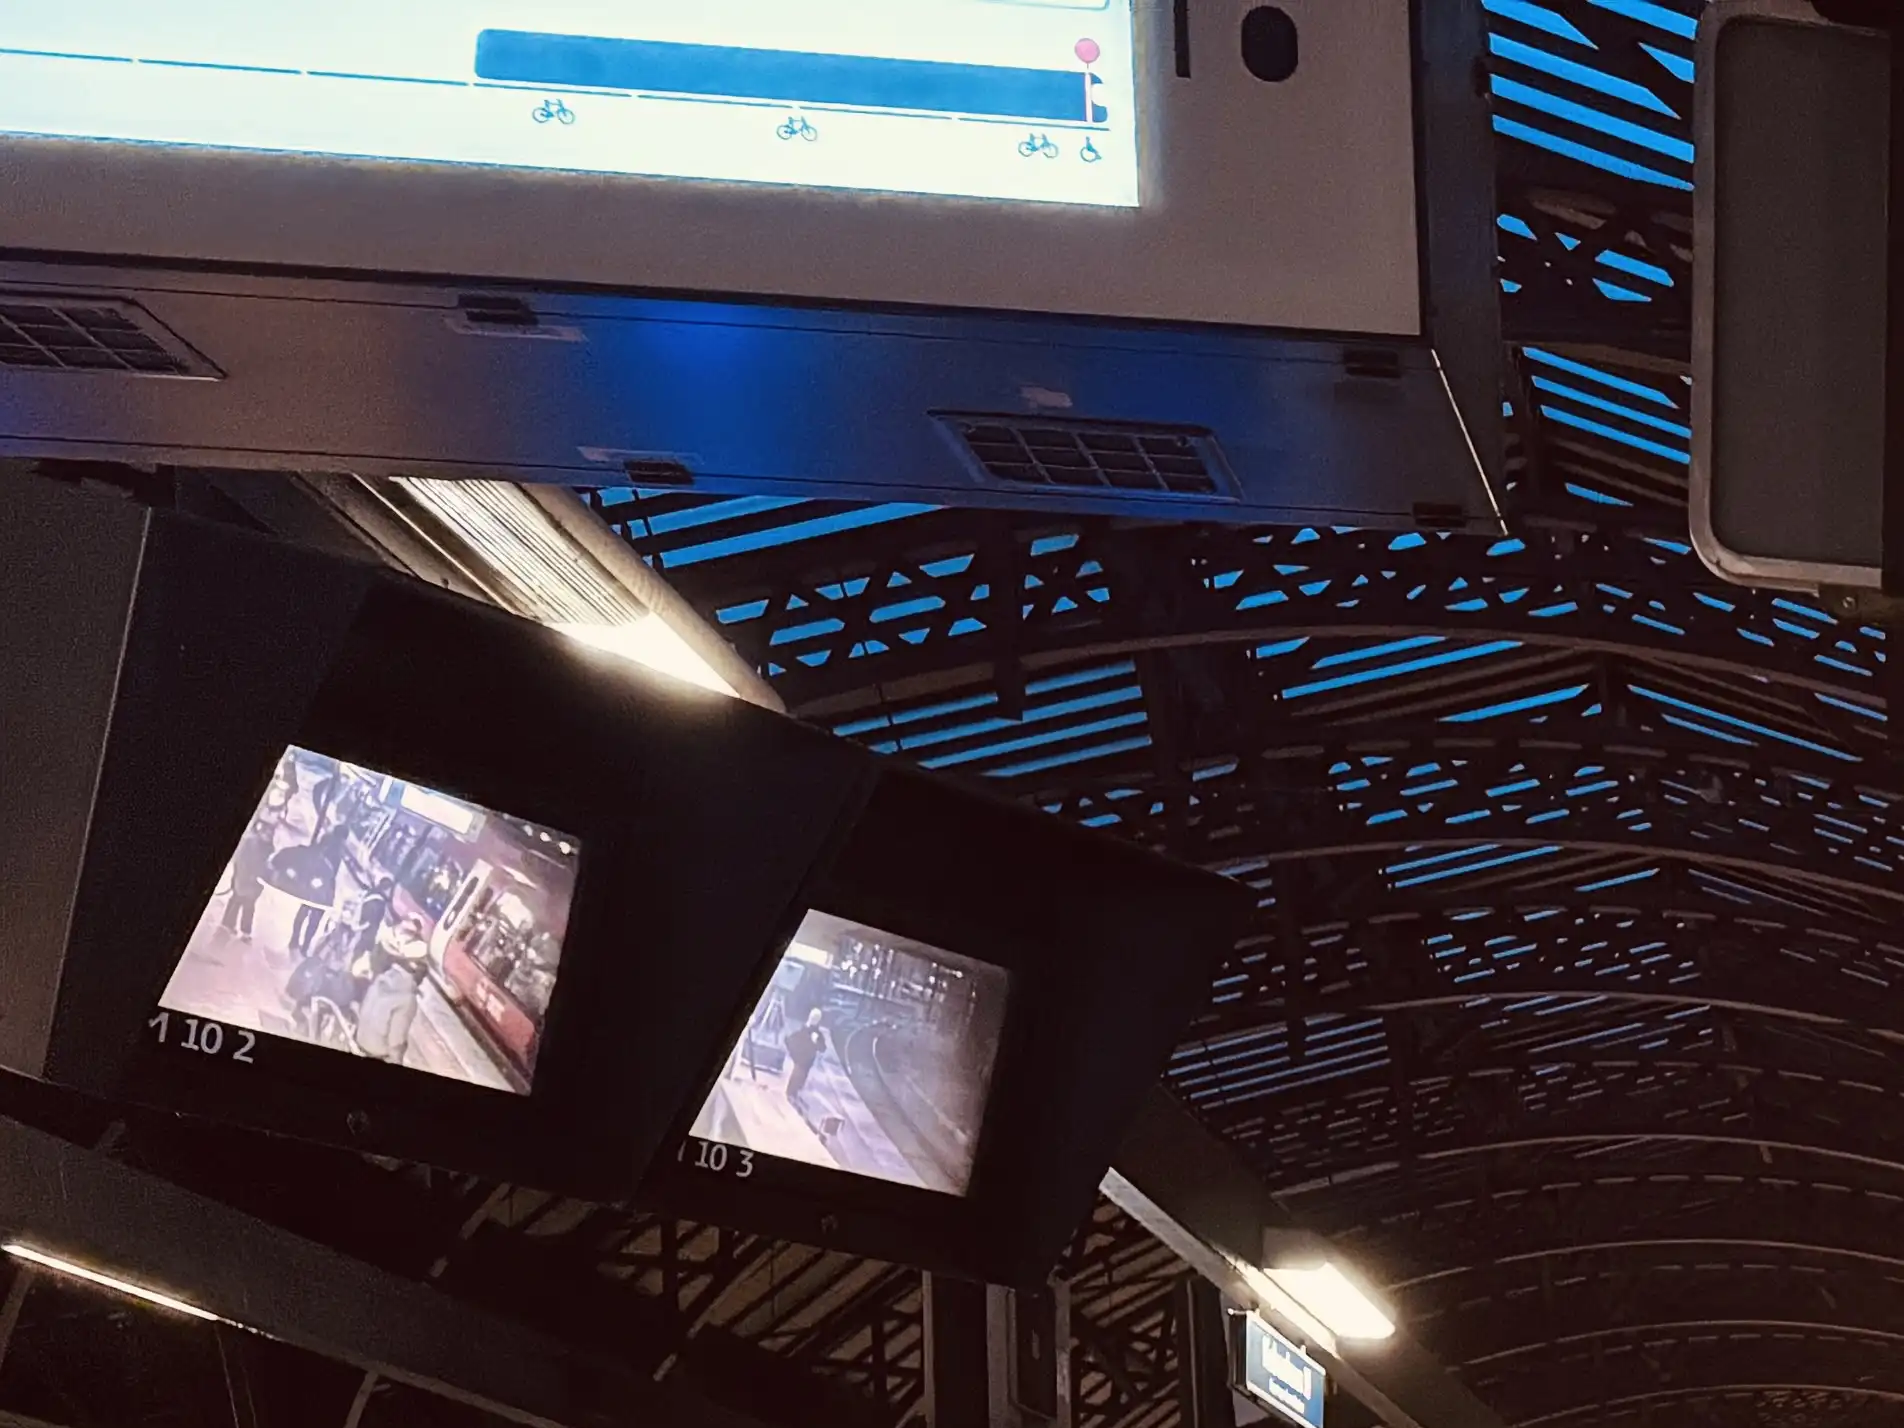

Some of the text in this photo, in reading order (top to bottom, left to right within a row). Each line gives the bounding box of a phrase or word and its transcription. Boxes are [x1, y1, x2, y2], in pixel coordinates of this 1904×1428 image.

[181, 1019, 223, 1054] 10
[232, 1030, 256, 1064] 2
[694, 1141, 728, 1171] 10
[735, 1150, 754, 1178] 3
